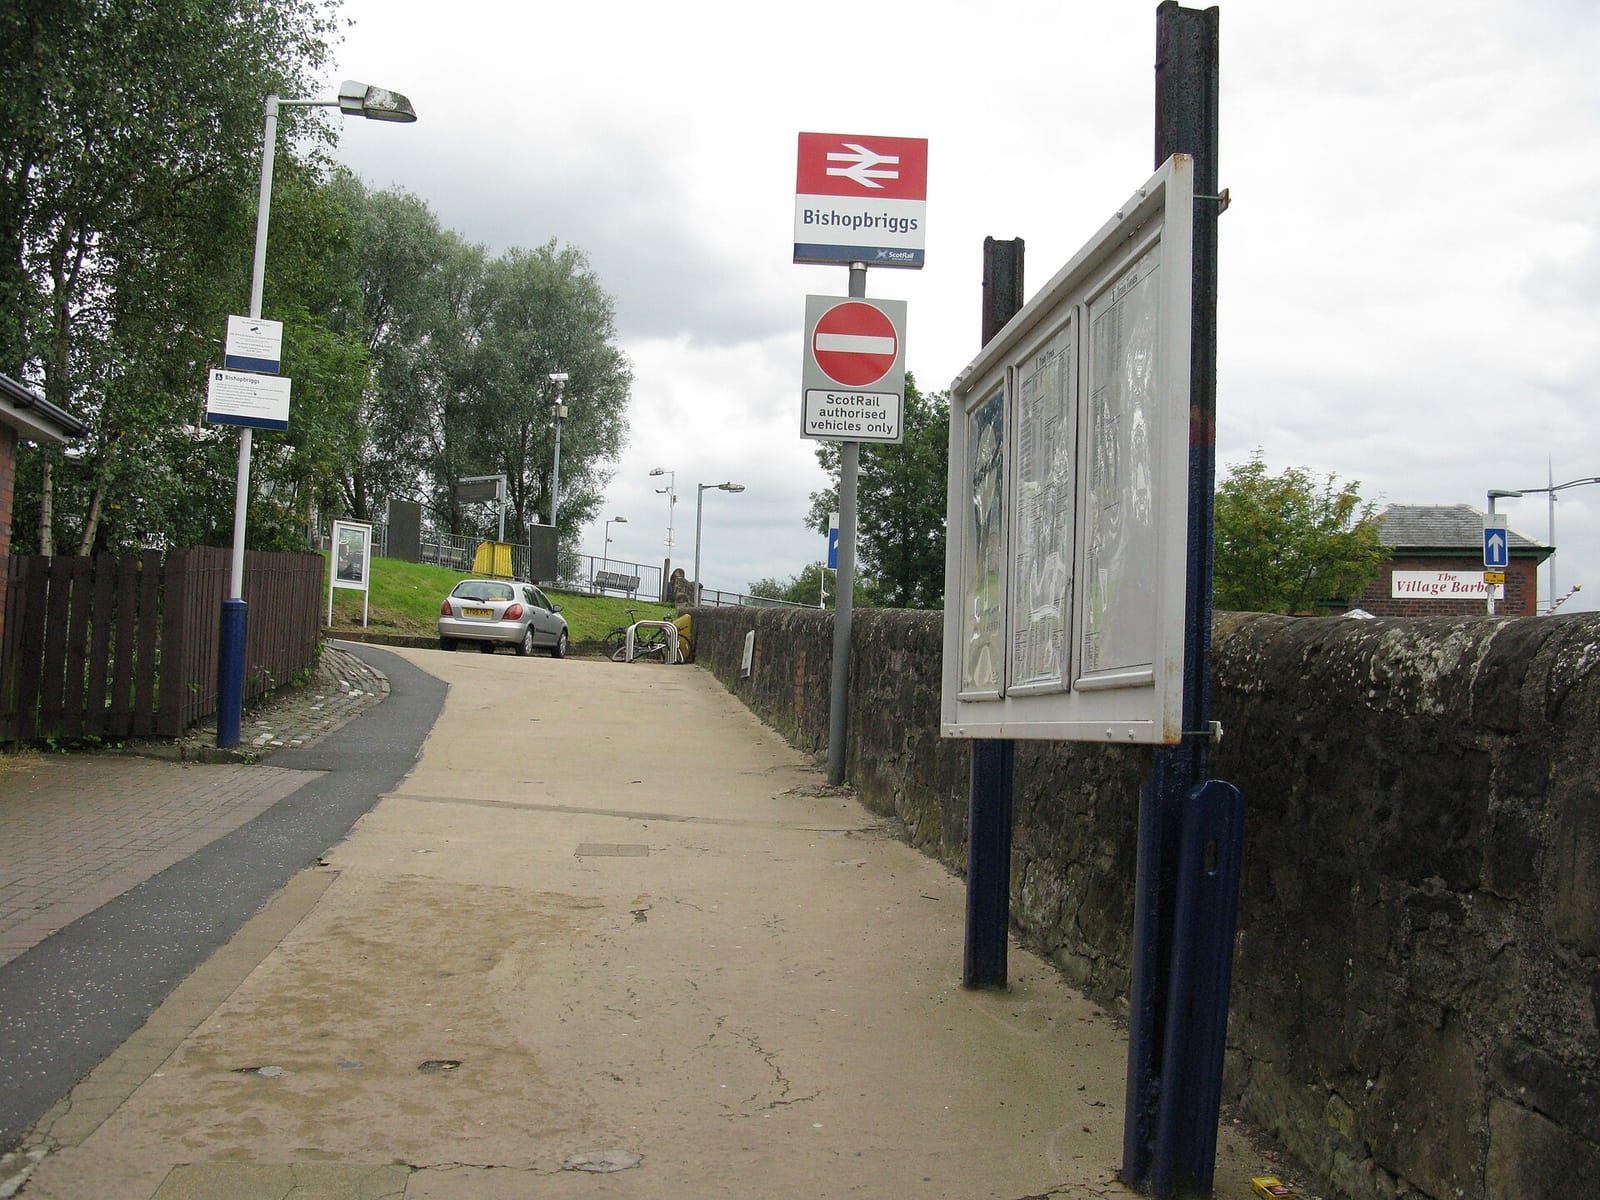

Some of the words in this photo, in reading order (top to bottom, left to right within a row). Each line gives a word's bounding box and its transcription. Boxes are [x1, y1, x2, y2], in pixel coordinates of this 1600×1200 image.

[803, 209, 918, 233] Bishopbriggs
[888, 251, 914, 259] ScotRail
[225, 374, 260, 385] Bishopbriggs
[826, 394, 880, 407] ScotRail
[819, 408, 886, 420] authorised
[811, 420, 861, 431] vehicles
[867, 422, 893, 434] only
[1437, 573, 1457, 582] The
[1397, 581, 1446, 594] Village
